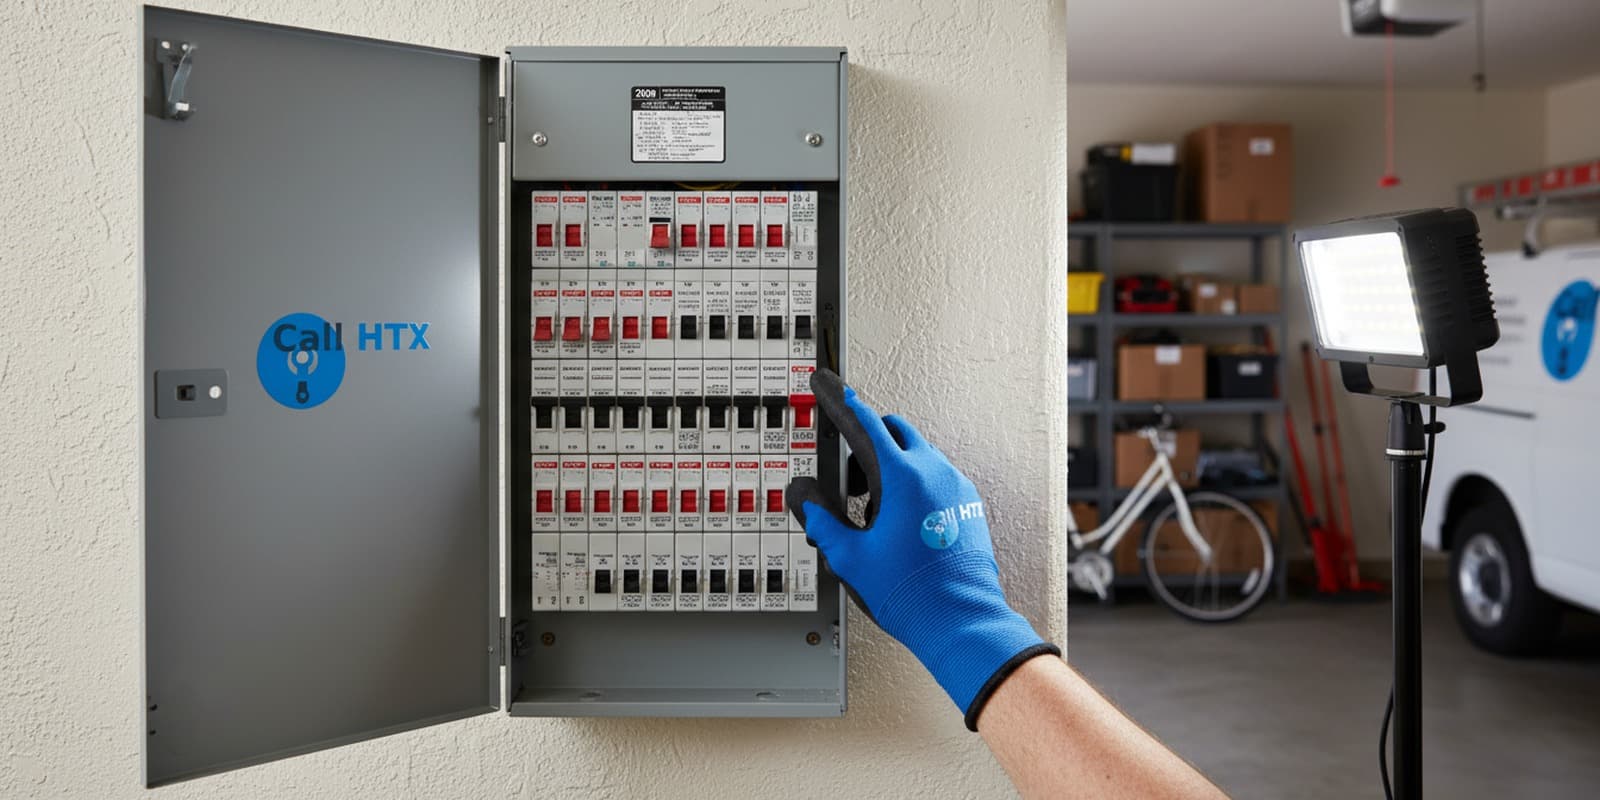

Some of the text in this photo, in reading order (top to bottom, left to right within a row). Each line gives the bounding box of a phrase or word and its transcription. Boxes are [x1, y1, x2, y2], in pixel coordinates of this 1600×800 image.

[273, 322, 431, 352] Call HTX
[922, 507, 956, 530] Call
